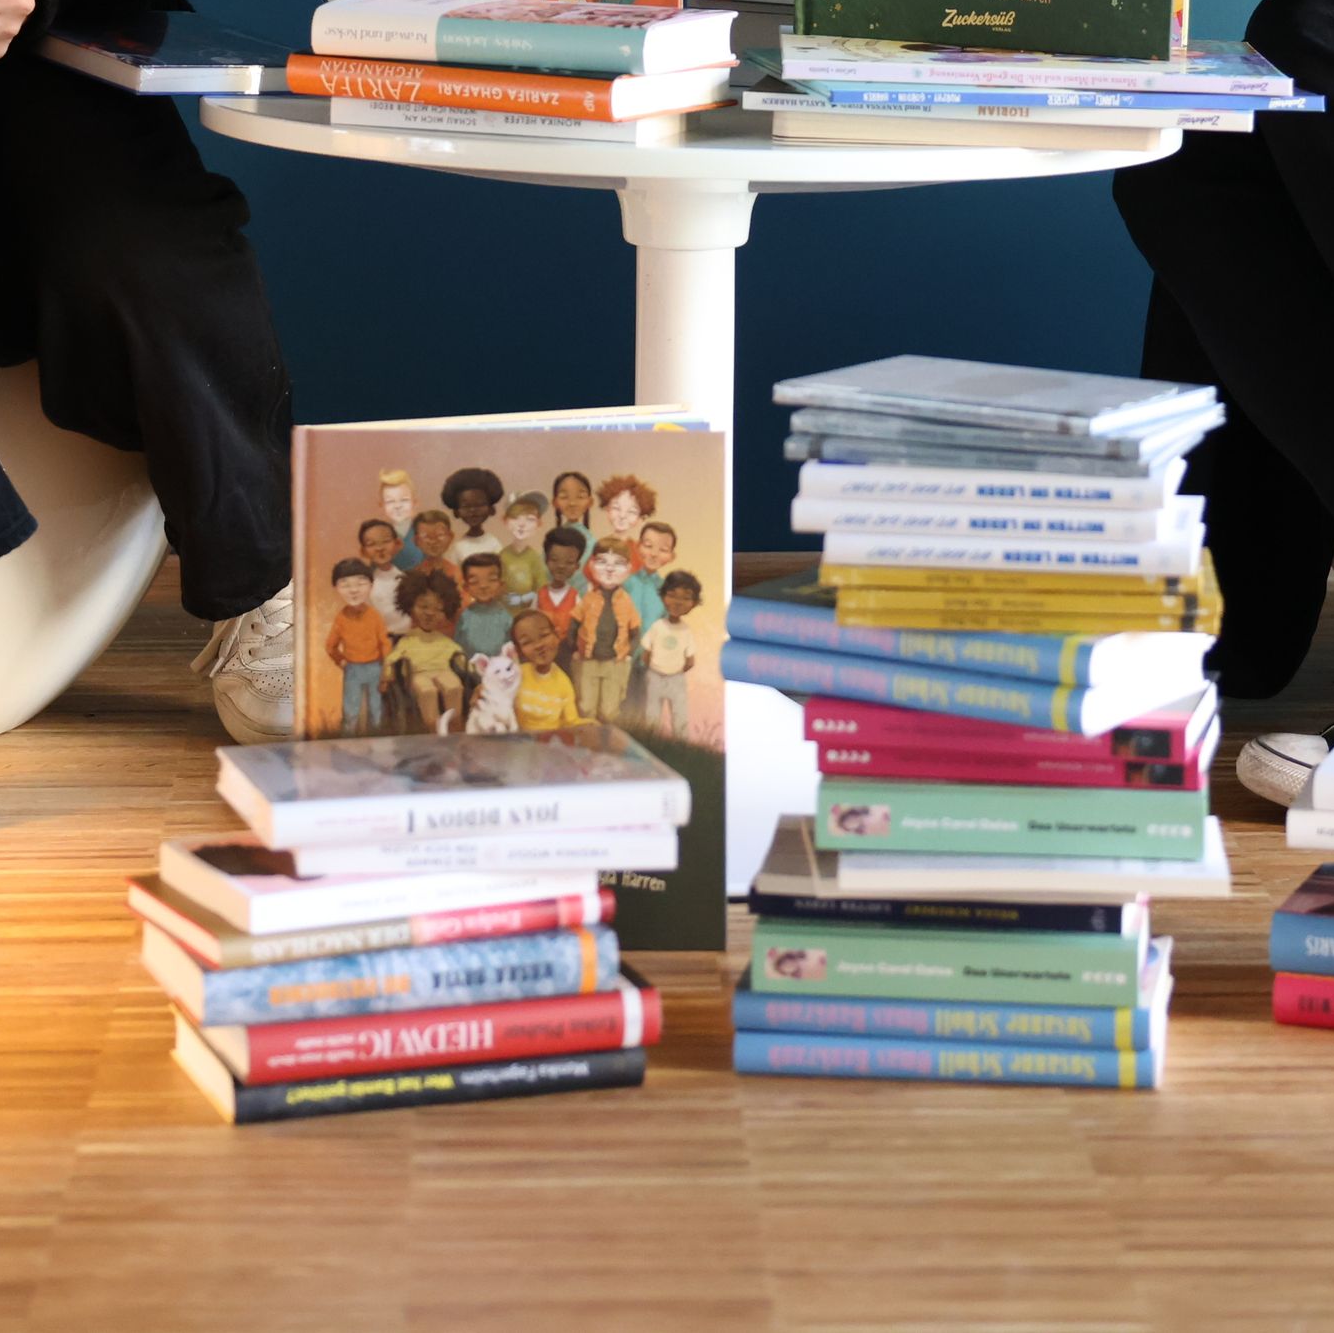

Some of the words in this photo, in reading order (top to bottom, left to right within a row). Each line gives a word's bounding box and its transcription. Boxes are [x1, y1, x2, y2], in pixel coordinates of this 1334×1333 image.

[942, 10, 1016, 28] Zuckersüß
[319, 60, 425, 79] AFGHANISTAN
[319, 74, 425, 104] ZARIFA
[438, 82, 502, 100] GHAFARI
[507, 89, 559, 105] ZARIFA
[761, 97, 797, 108] HARREN
[799, 99, 826, 108] KAYLA
[978, 106, 1029, 118] FLORIAN
[421, 115, 444, 125] MICH
[447, 117, 476, 126] SCHAU
[504, 115, 537, 125] HELFER
[538, 117, 581, 127] MONIKA
[621, 870, 666, 892] Harren
[357, 1018, 494, 1060] HEDWIG
